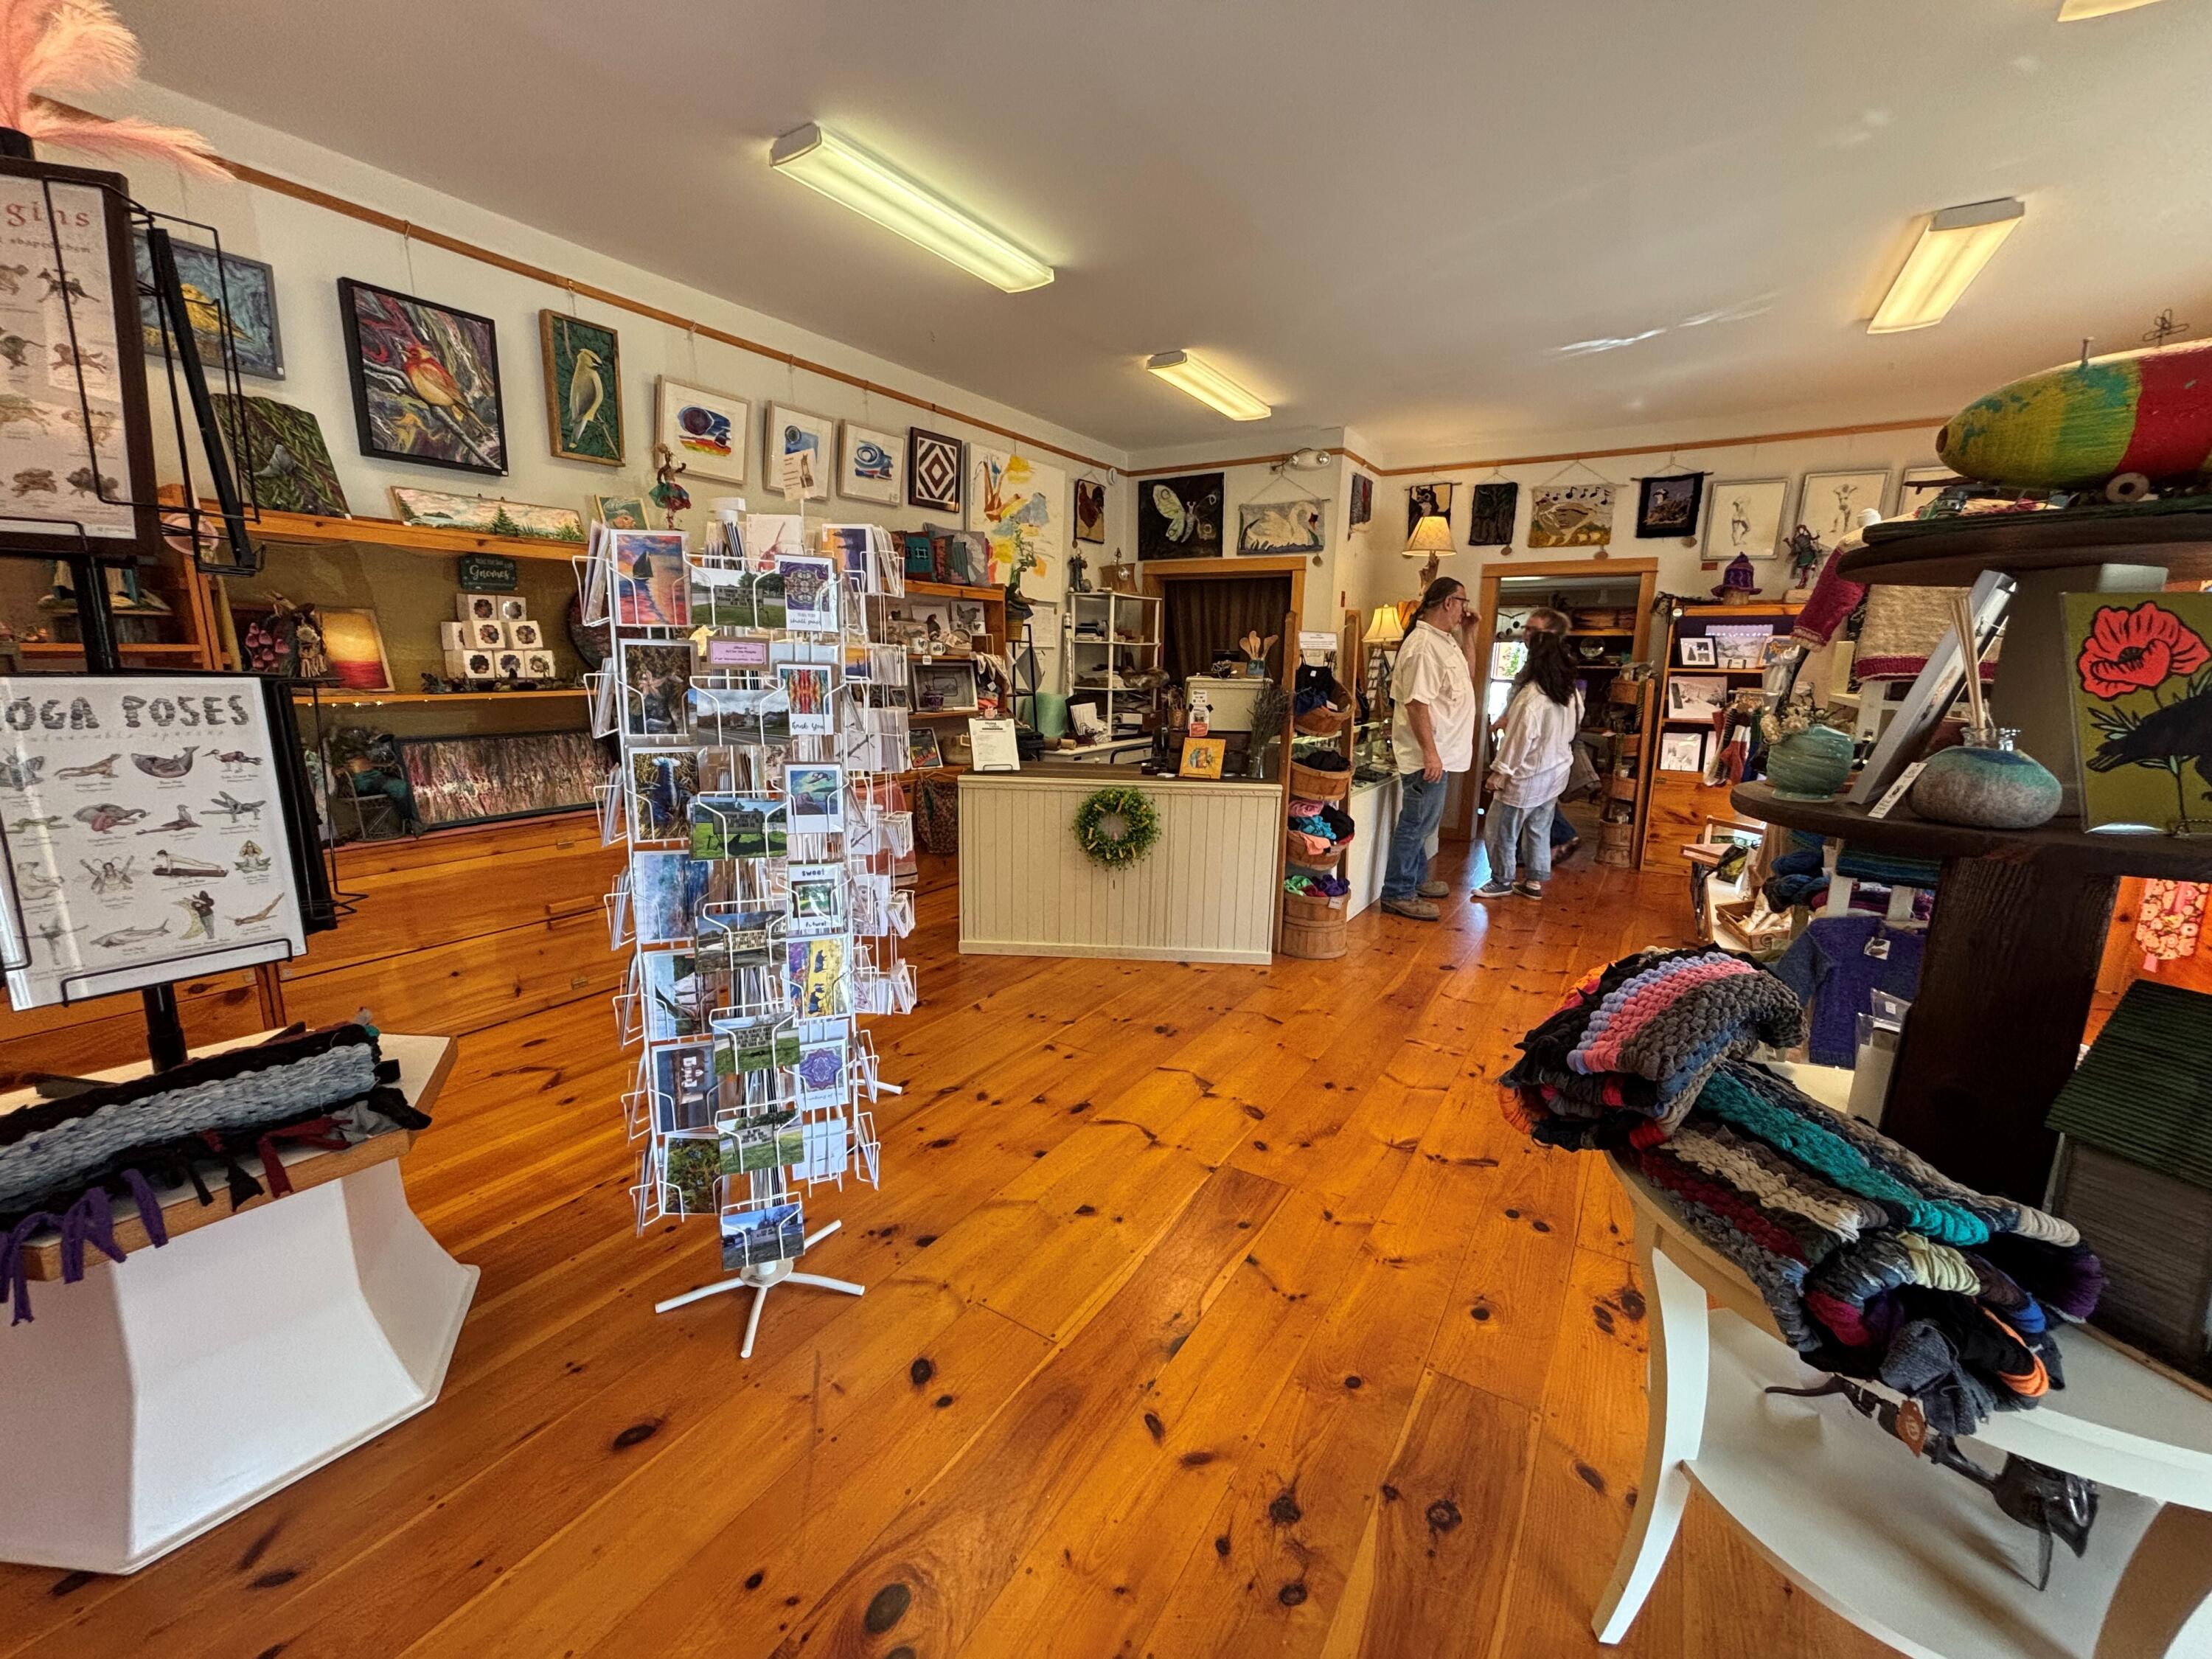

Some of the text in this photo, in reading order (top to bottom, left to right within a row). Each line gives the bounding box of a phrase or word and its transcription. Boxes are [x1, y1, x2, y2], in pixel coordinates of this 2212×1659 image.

[469, 565, 509, 580] Gnomes
[0, 695, 249, 731] OGA POSES
